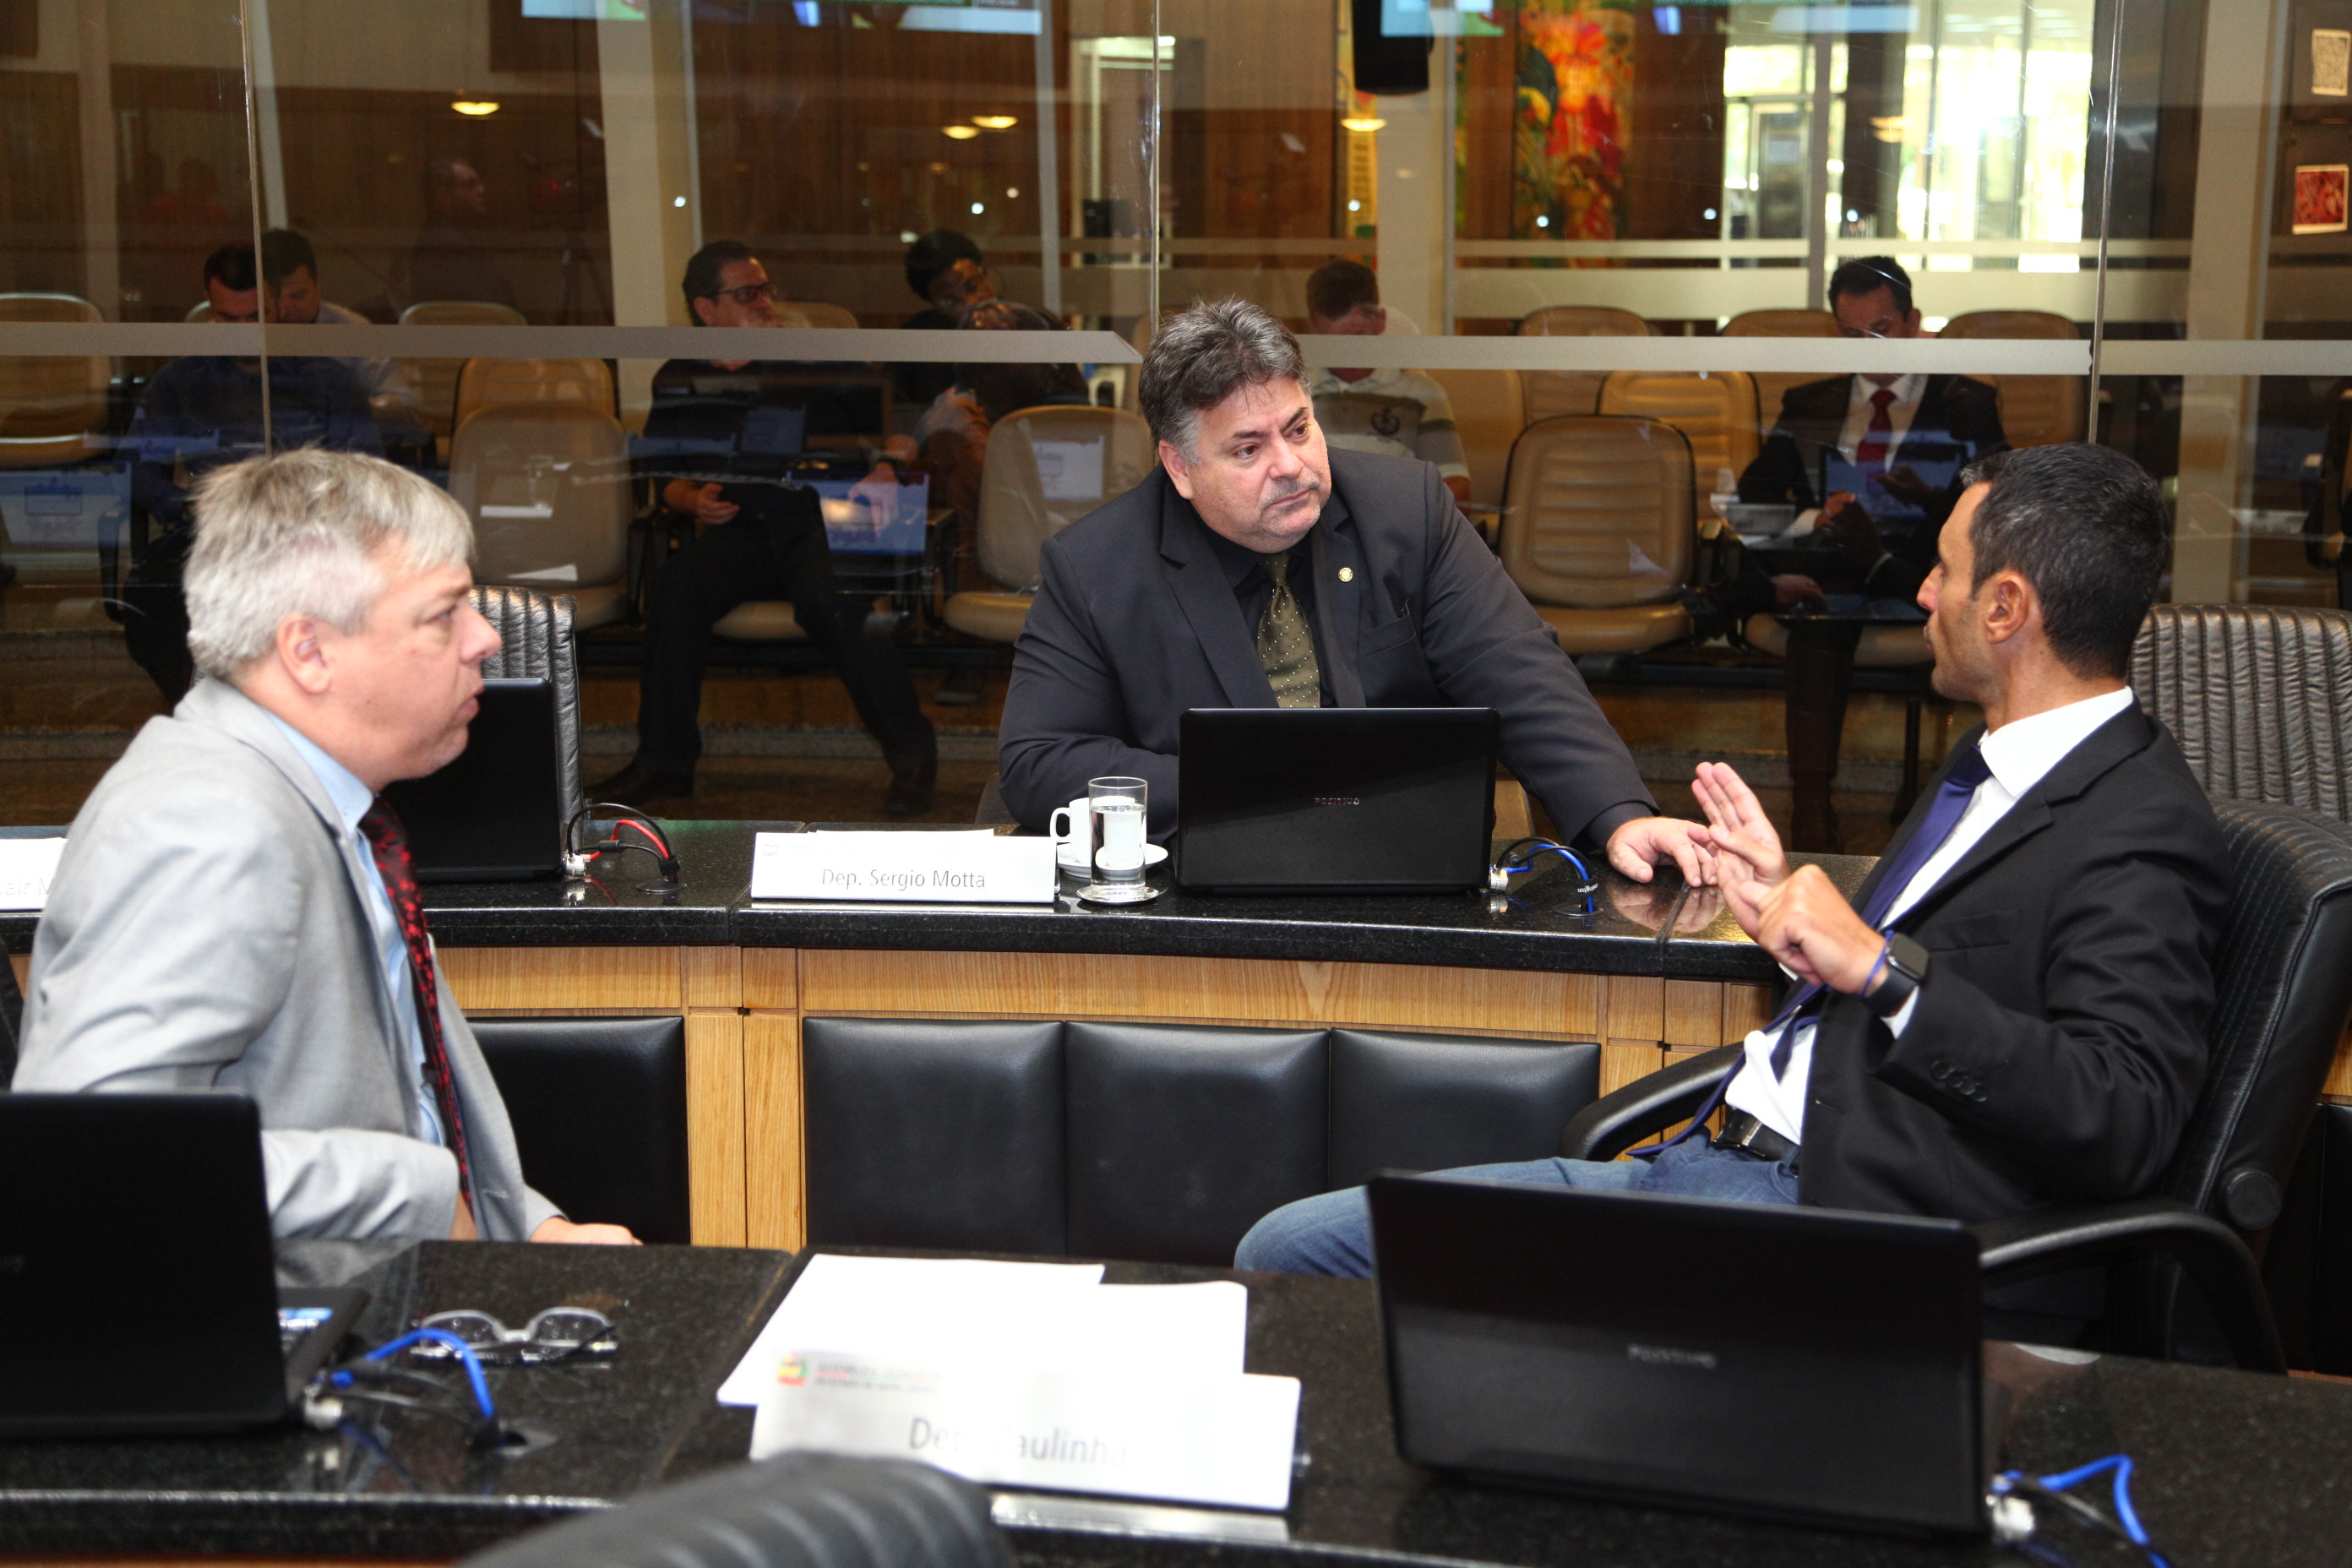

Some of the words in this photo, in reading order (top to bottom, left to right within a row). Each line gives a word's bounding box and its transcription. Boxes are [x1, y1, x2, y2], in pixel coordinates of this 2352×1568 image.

[821, 868, 861, 890] Dep.
[869, 868, 925, 891] Sergio
[932, 869, 986, 888] Motta
